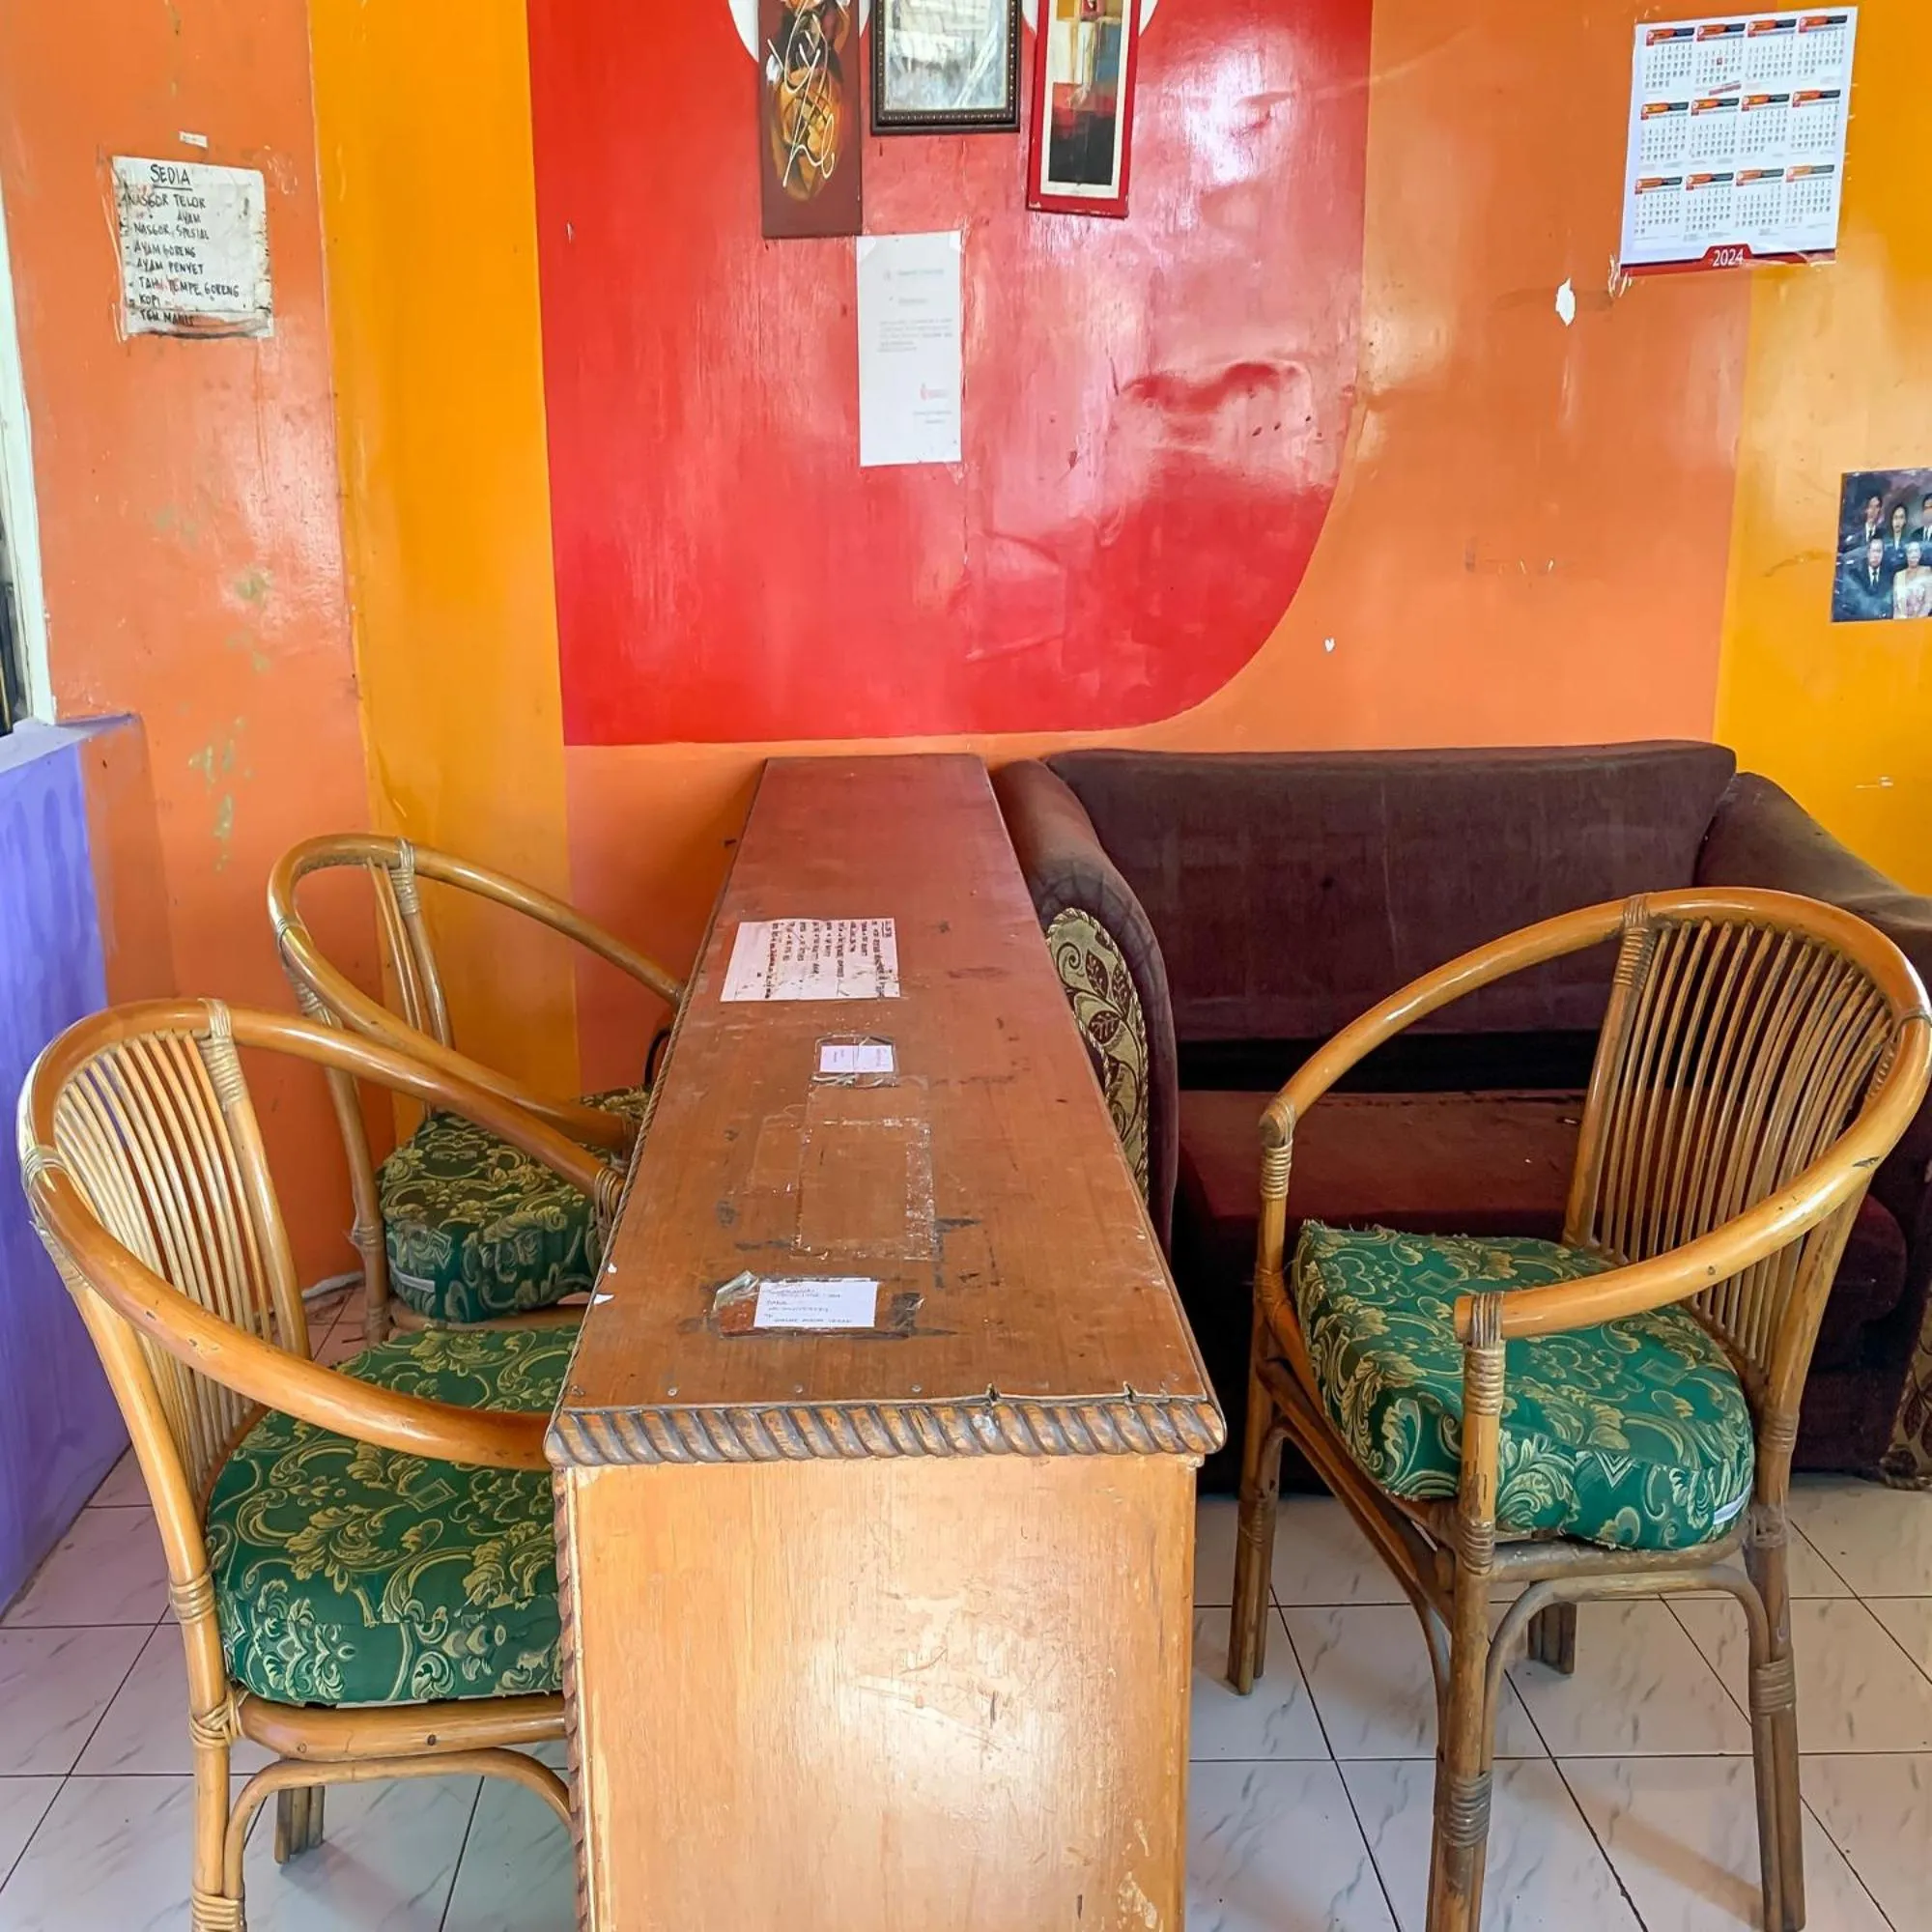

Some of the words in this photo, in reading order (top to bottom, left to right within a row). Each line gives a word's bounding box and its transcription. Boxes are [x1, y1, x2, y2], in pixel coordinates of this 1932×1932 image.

[150, 163, 191, 185] SEDIA
[177, 210, 201, 224] AYAM
[136, 257, 163, 272] AYAM
[1712, 247, 1745, 268] 2024
